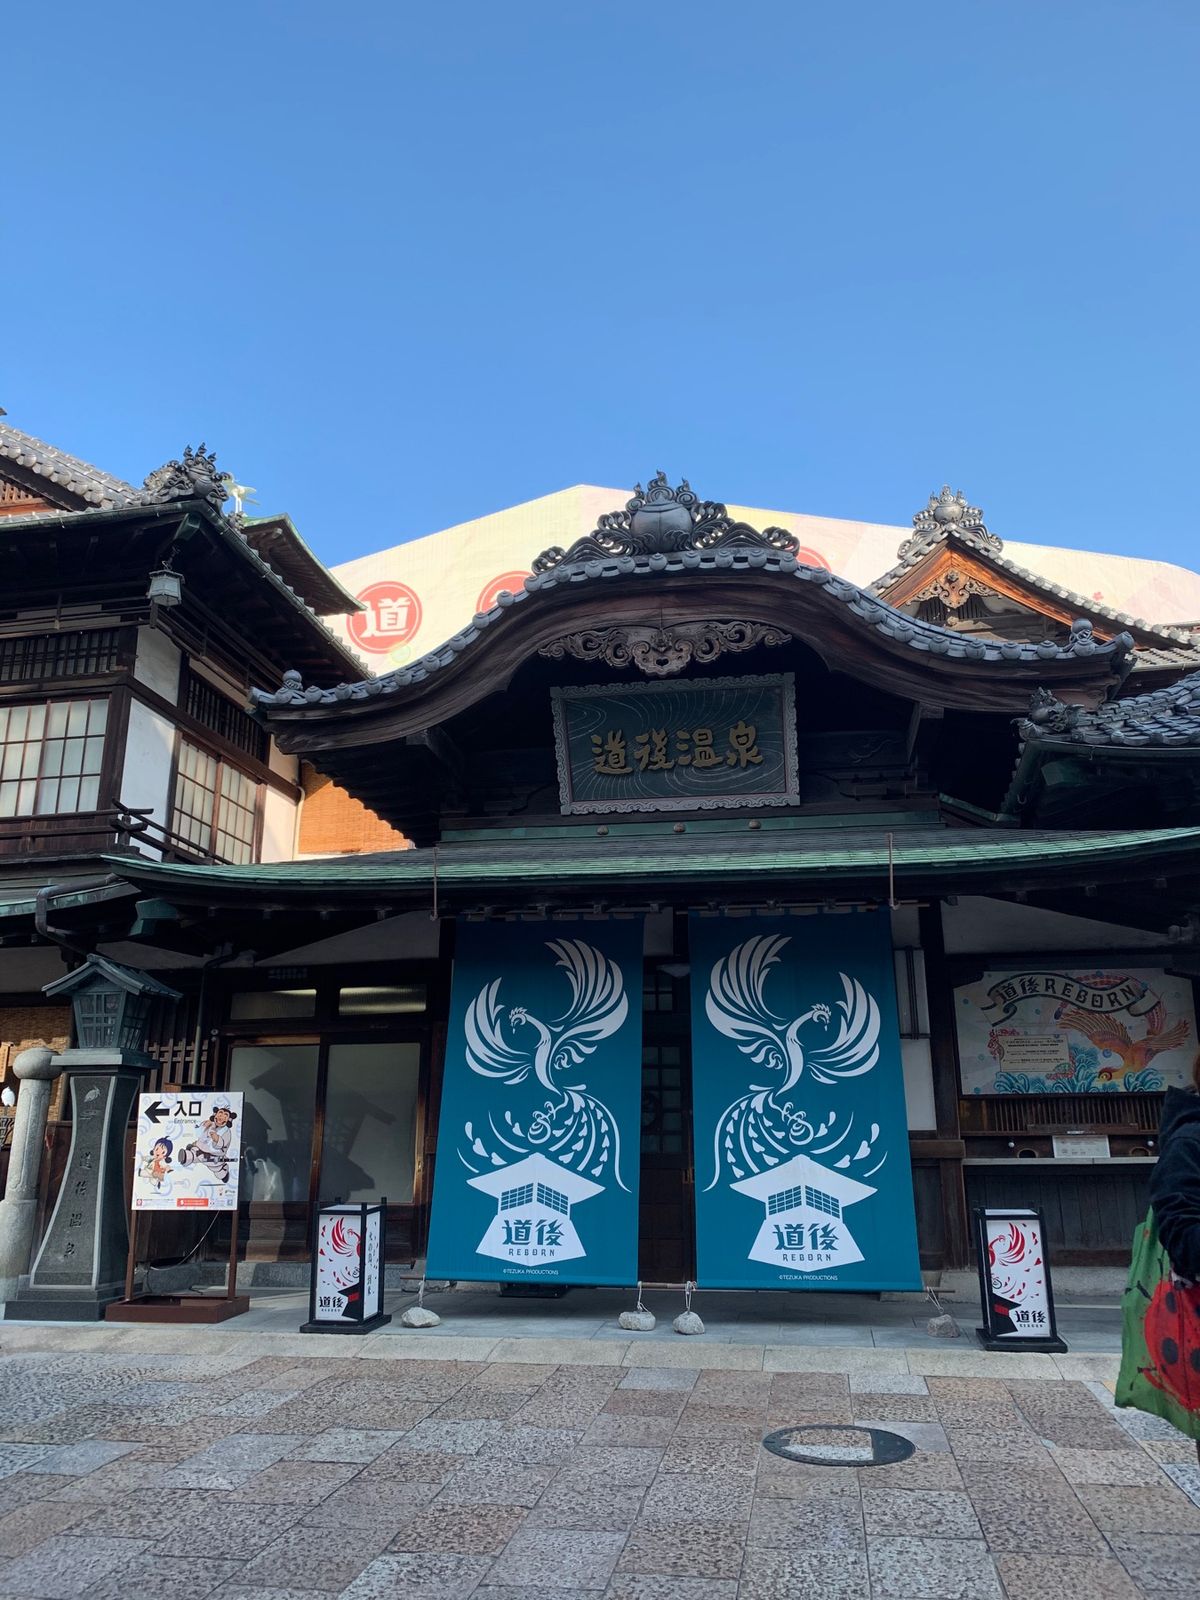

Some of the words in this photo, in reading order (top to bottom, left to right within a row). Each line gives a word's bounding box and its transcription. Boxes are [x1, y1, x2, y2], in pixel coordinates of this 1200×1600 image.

[357, 596, 412, 639] 道
[591, 720, 764, 775] 道後温泉
[1000, 976, 1040, 1004] 道後
[1043, 978, 1136, 1008] REBORN
[174, 1100, 202, 1117] 入口
[502, 1219, 565, 1247] 道後
[772, 1223, 839, 1251] 道後
[508, 1248, 555, 1257] REBORN
[782, 1253, 832, 1262] REBORN
[526, 1268, 559, 1276] PRODUCTIONS
[319, 1296, 344, 1308] 道後
[1015, 1310, 1047, 1324] 道後
